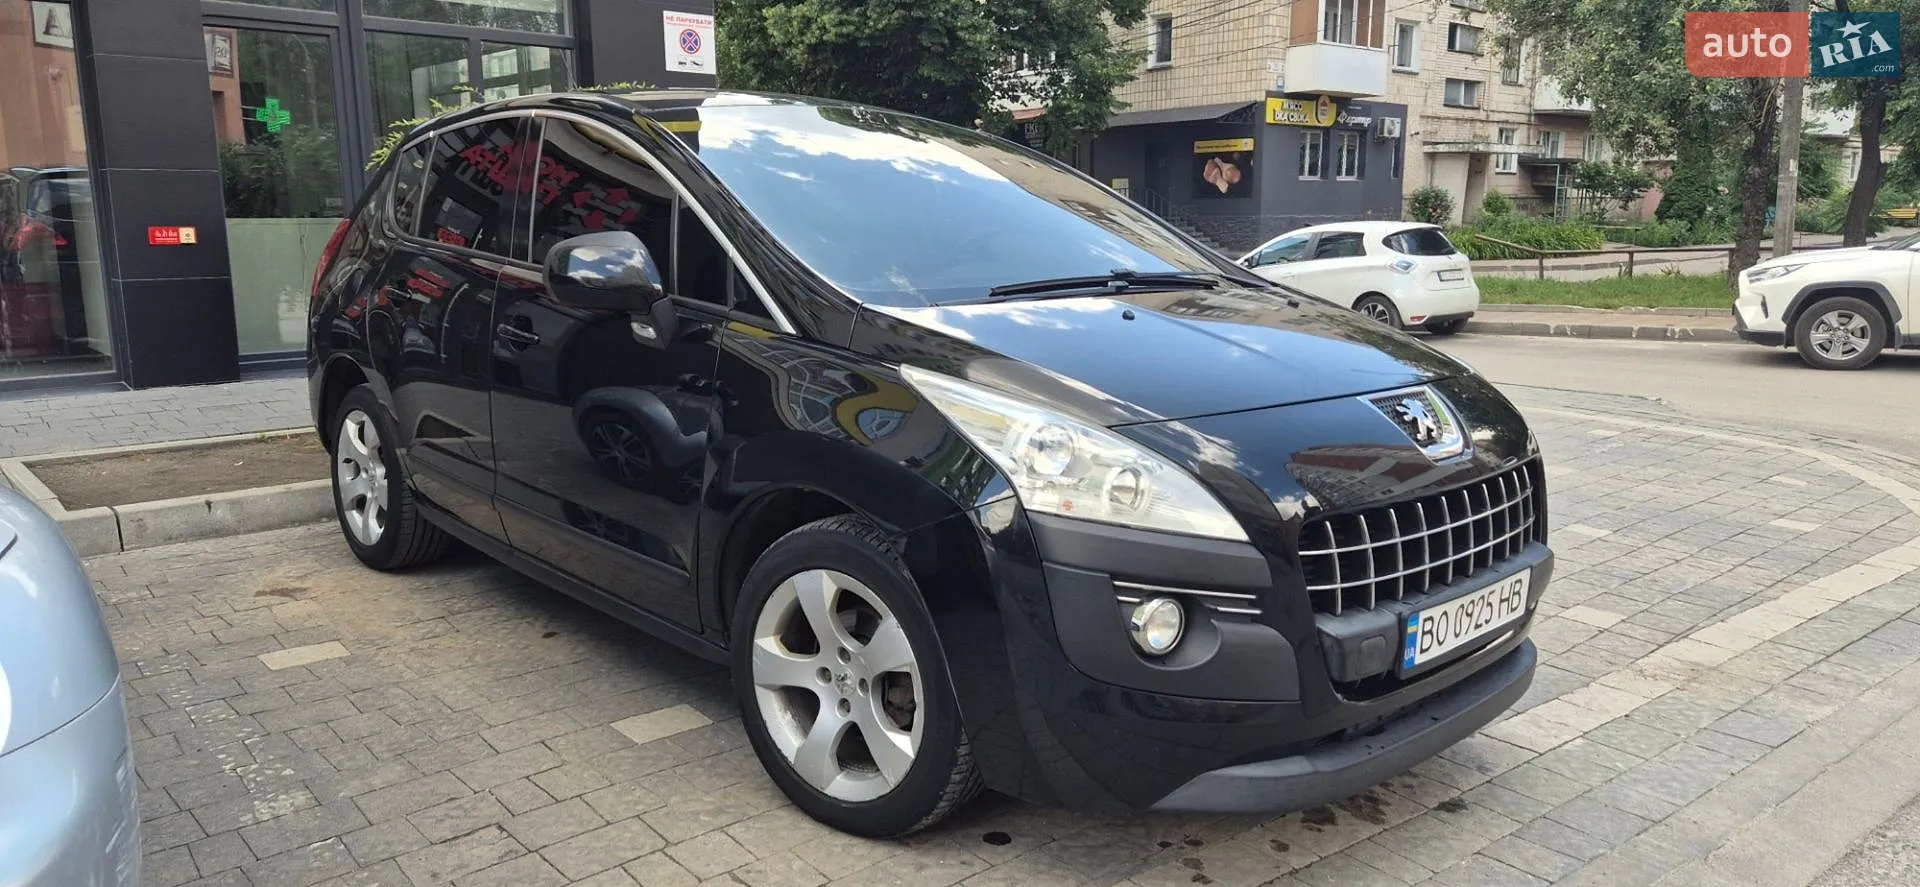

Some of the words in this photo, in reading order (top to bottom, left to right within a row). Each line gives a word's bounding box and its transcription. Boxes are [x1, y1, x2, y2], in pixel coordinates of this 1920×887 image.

[676, 16, 712, 25] ПАРКУВАТИ
[1419, 609, 1449, 655] BO
[1453, 589, 1497, 639] 0925
[1498, 578, 1523, 619] HB
